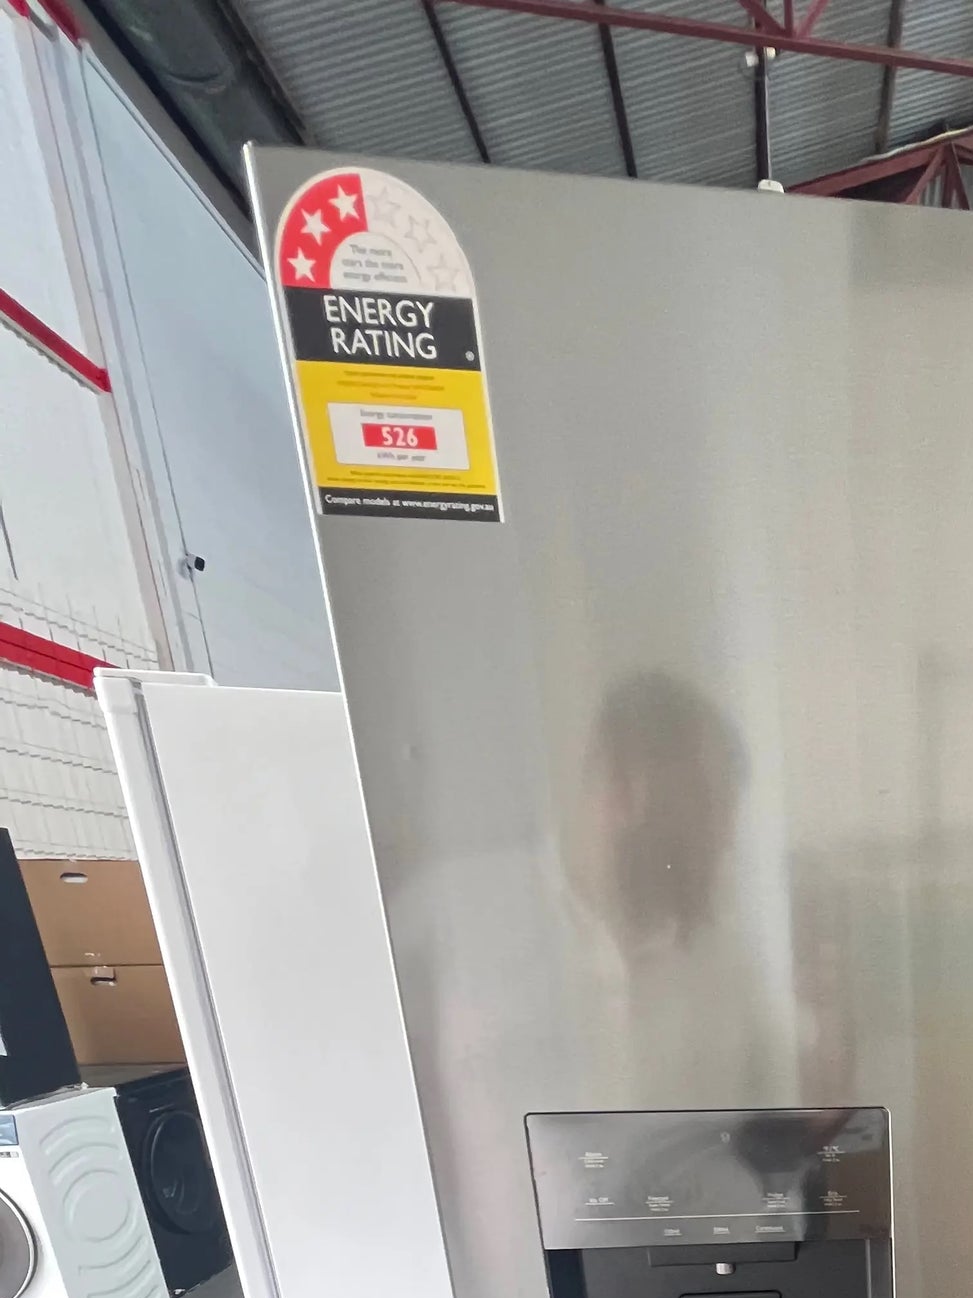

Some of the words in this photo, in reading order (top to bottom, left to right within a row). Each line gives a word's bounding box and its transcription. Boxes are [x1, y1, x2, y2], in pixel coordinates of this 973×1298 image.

[323, 294, 435, 328] ENERGY
[330, 327, 438, 360] RATING
[381, 425, 419, 448] 526
[324, 494, 362, 507] Compare
[363, 497, 391, 507] models
